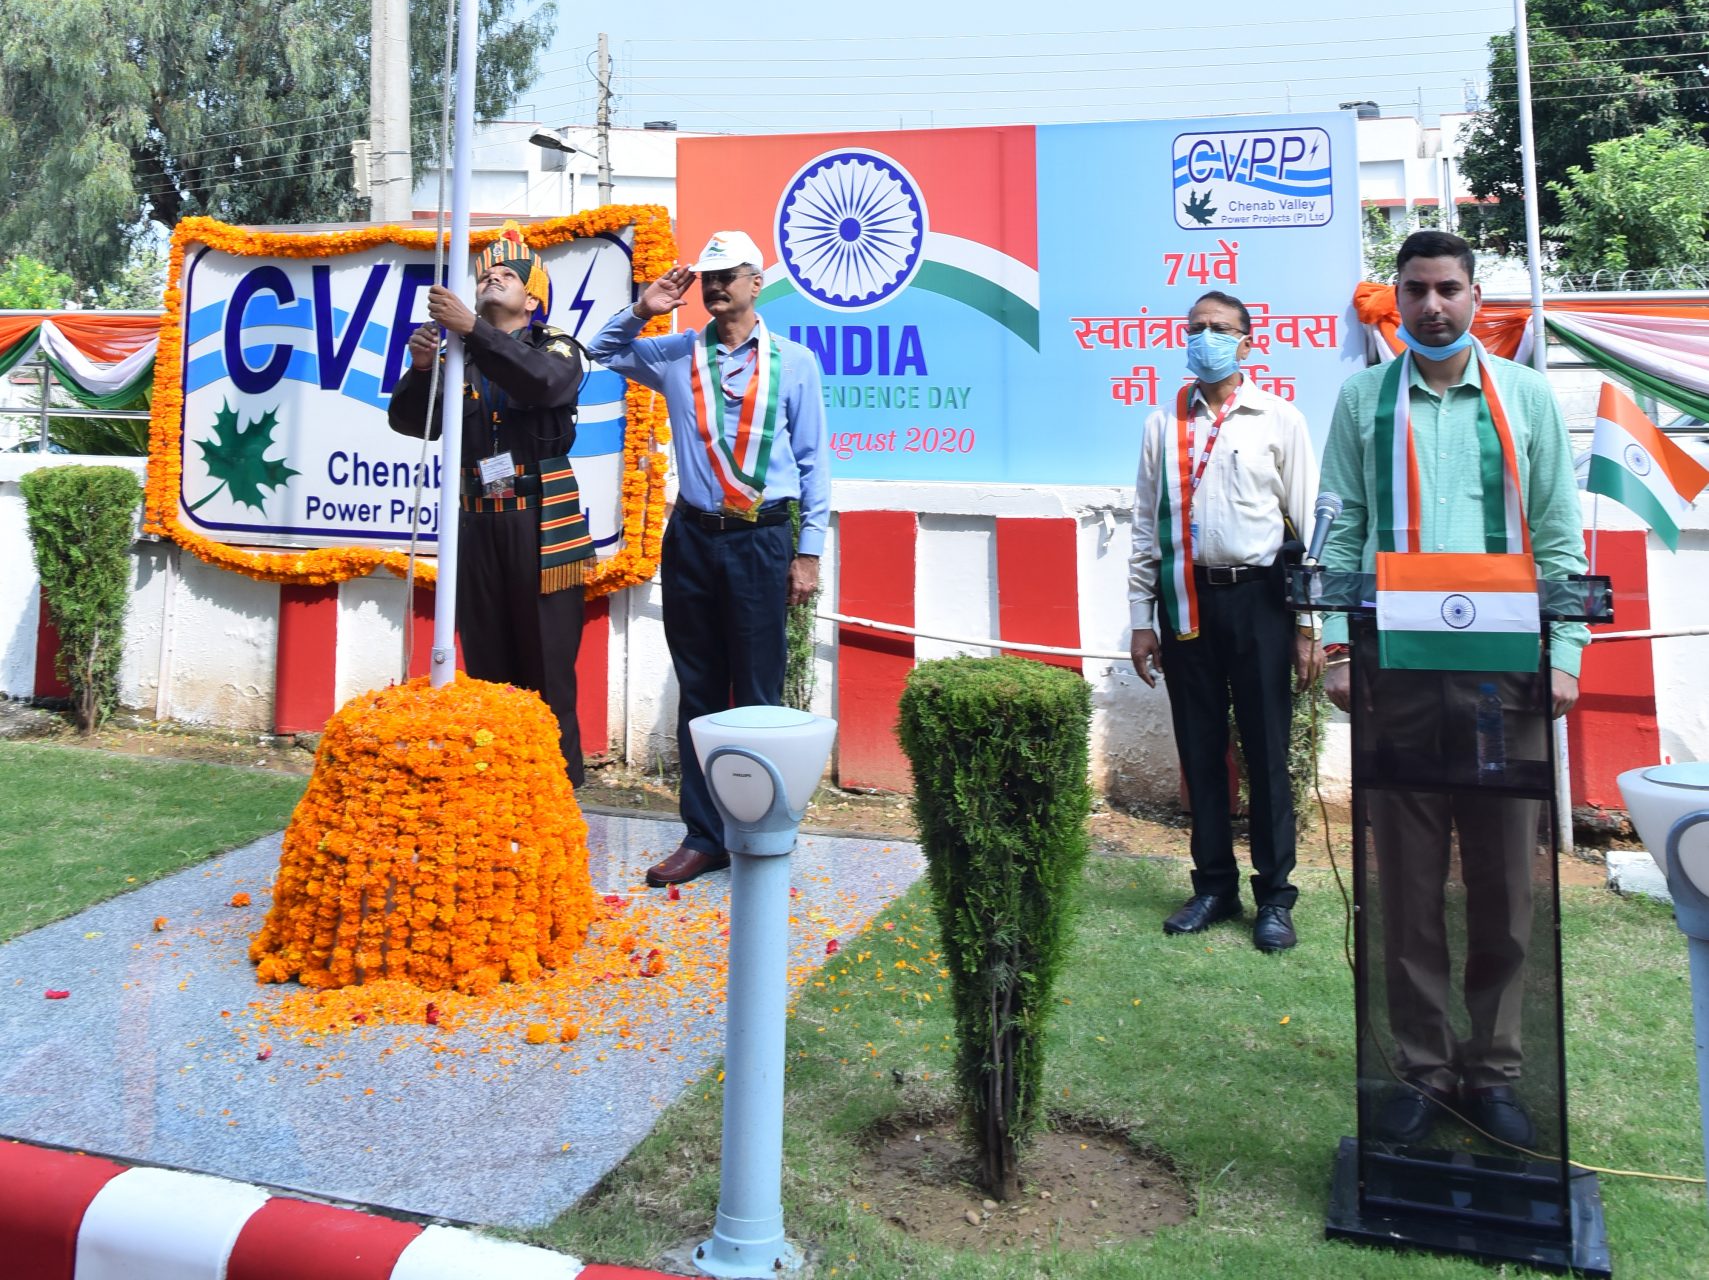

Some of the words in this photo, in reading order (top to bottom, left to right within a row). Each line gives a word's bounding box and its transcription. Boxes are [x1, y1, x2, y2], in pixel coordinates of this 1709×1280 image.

[1188, 136, 1306, 183] CVPP
[1221, 215, 1250, 224] Power
[1252, 214, 1291, 224] Projects
[1293, 213, 1307, 223] (P)
[1309, 213, 1325, 222] Ltd
[1228, 200, 1276, 212] Chenab
[1279, 198, 1316, 211] Valley
[1163, 239, 1239, 285] 74वें
[224, 263, 552, 394] CVP
[822, 386, 920, 409] ENDENCE
[928, 387, 971, 409] DAY
[1110, 366, 1160, 405] की
[903, 427, 976, 454] 2020
[306, 495, 382, 523] Power
[390, 499, 439, 532] Proj
